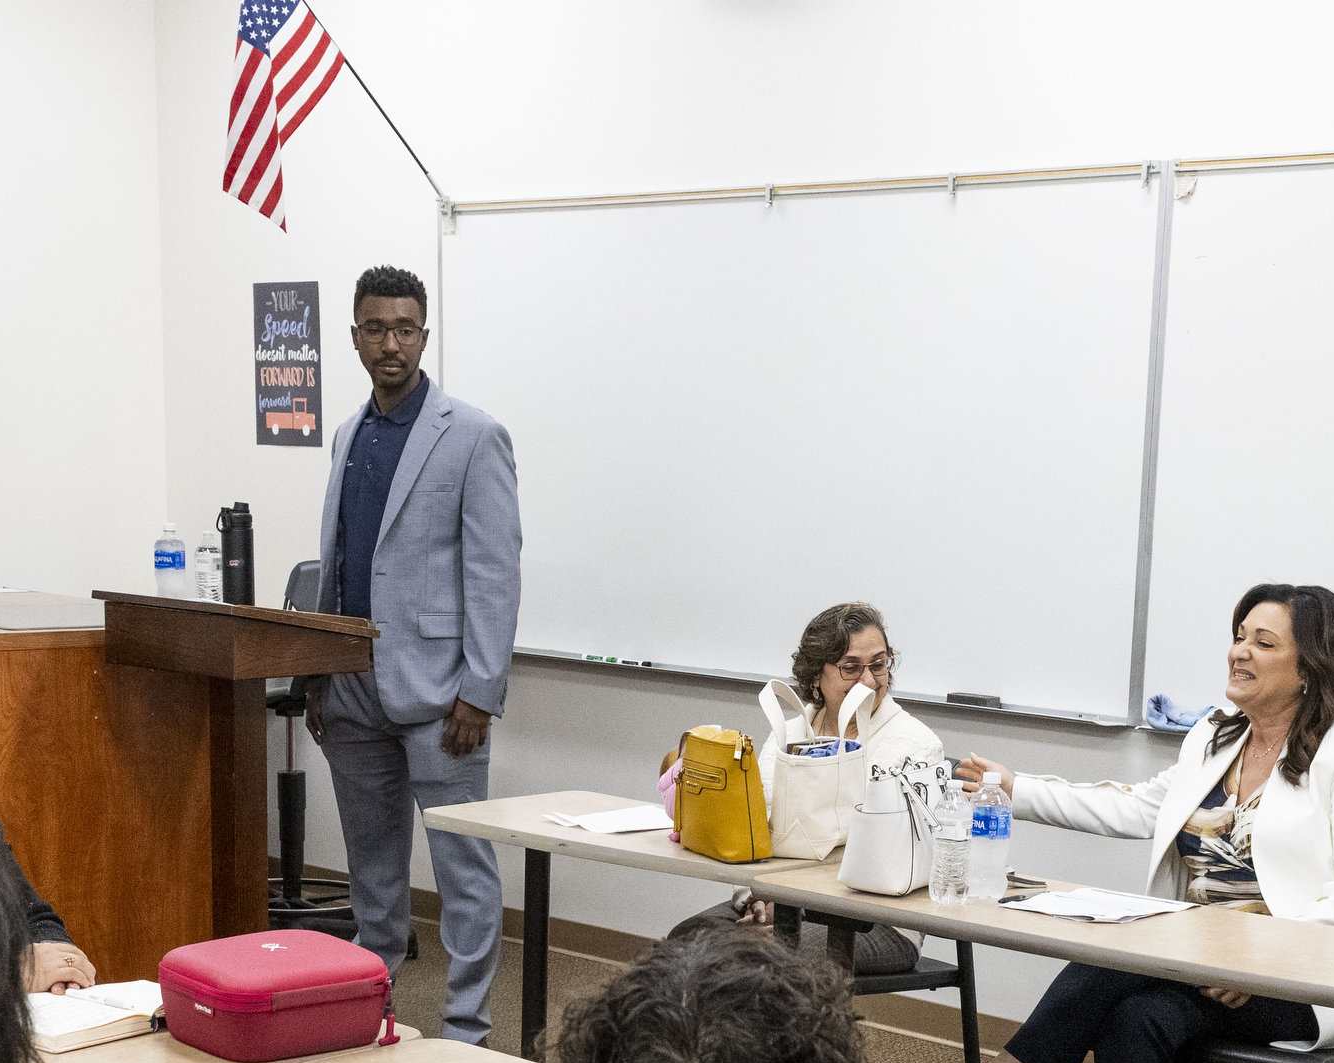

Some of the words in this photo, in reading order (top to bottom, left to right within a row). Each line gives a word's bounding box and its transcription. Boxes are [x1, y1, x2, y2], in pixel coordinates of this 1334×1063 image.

[261, 305, 311, 349] Speed
[287, 343, 319, 362] matter
[260, 366, 305, 387] FORWARD
[306, 366, 316, 387] IS
[258, 391, 292, 413] forward
